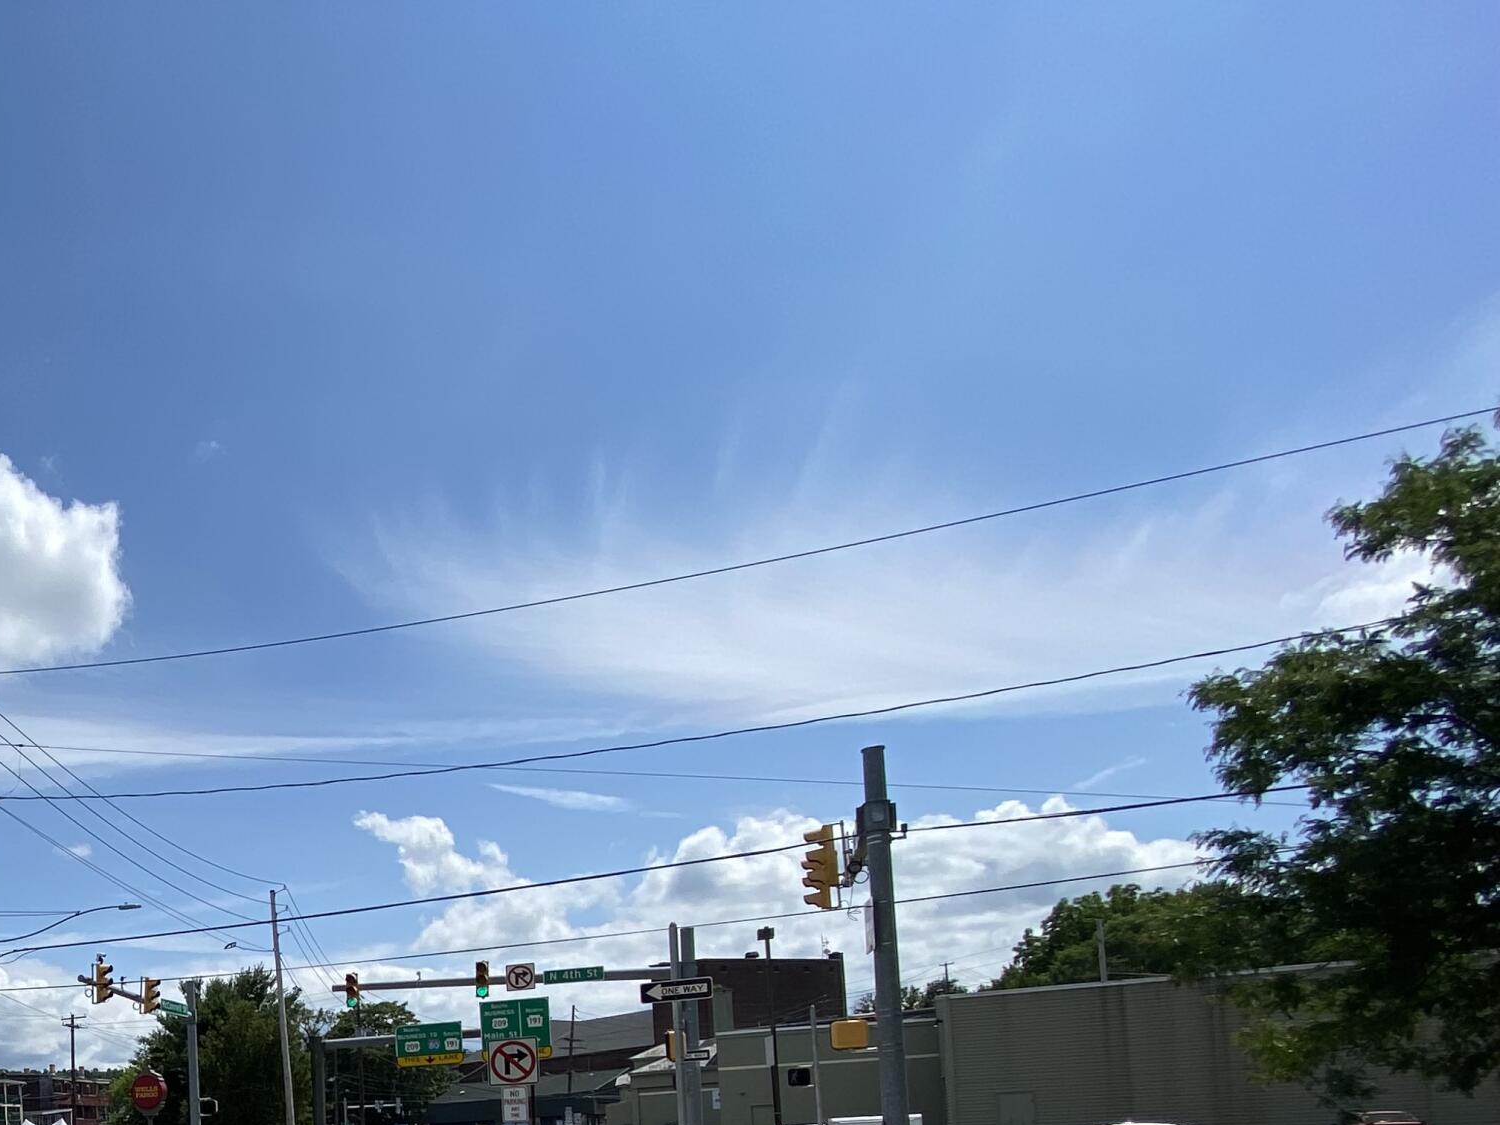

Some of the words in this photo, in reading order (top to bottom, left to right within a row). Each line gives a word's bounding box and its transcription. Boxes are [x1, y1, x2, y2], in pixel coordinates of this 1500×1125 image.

[550, 972, 557, 980] N
[562, 970, 581, 979] 4th
[586, 968, 597, 978] St
[661, 986, 679, 995] ONE
[683, 984, 704, 993] WAY
[494, 1019, 507, 1027] 209
[529, 1017, 541, 1025] 191
[484, 1032, 505, 1040] Main
[407, 1043, 419, 1051] 209
[446, 1040, 458, 1048] 191
[509, 1090, 520, 1098] NO
